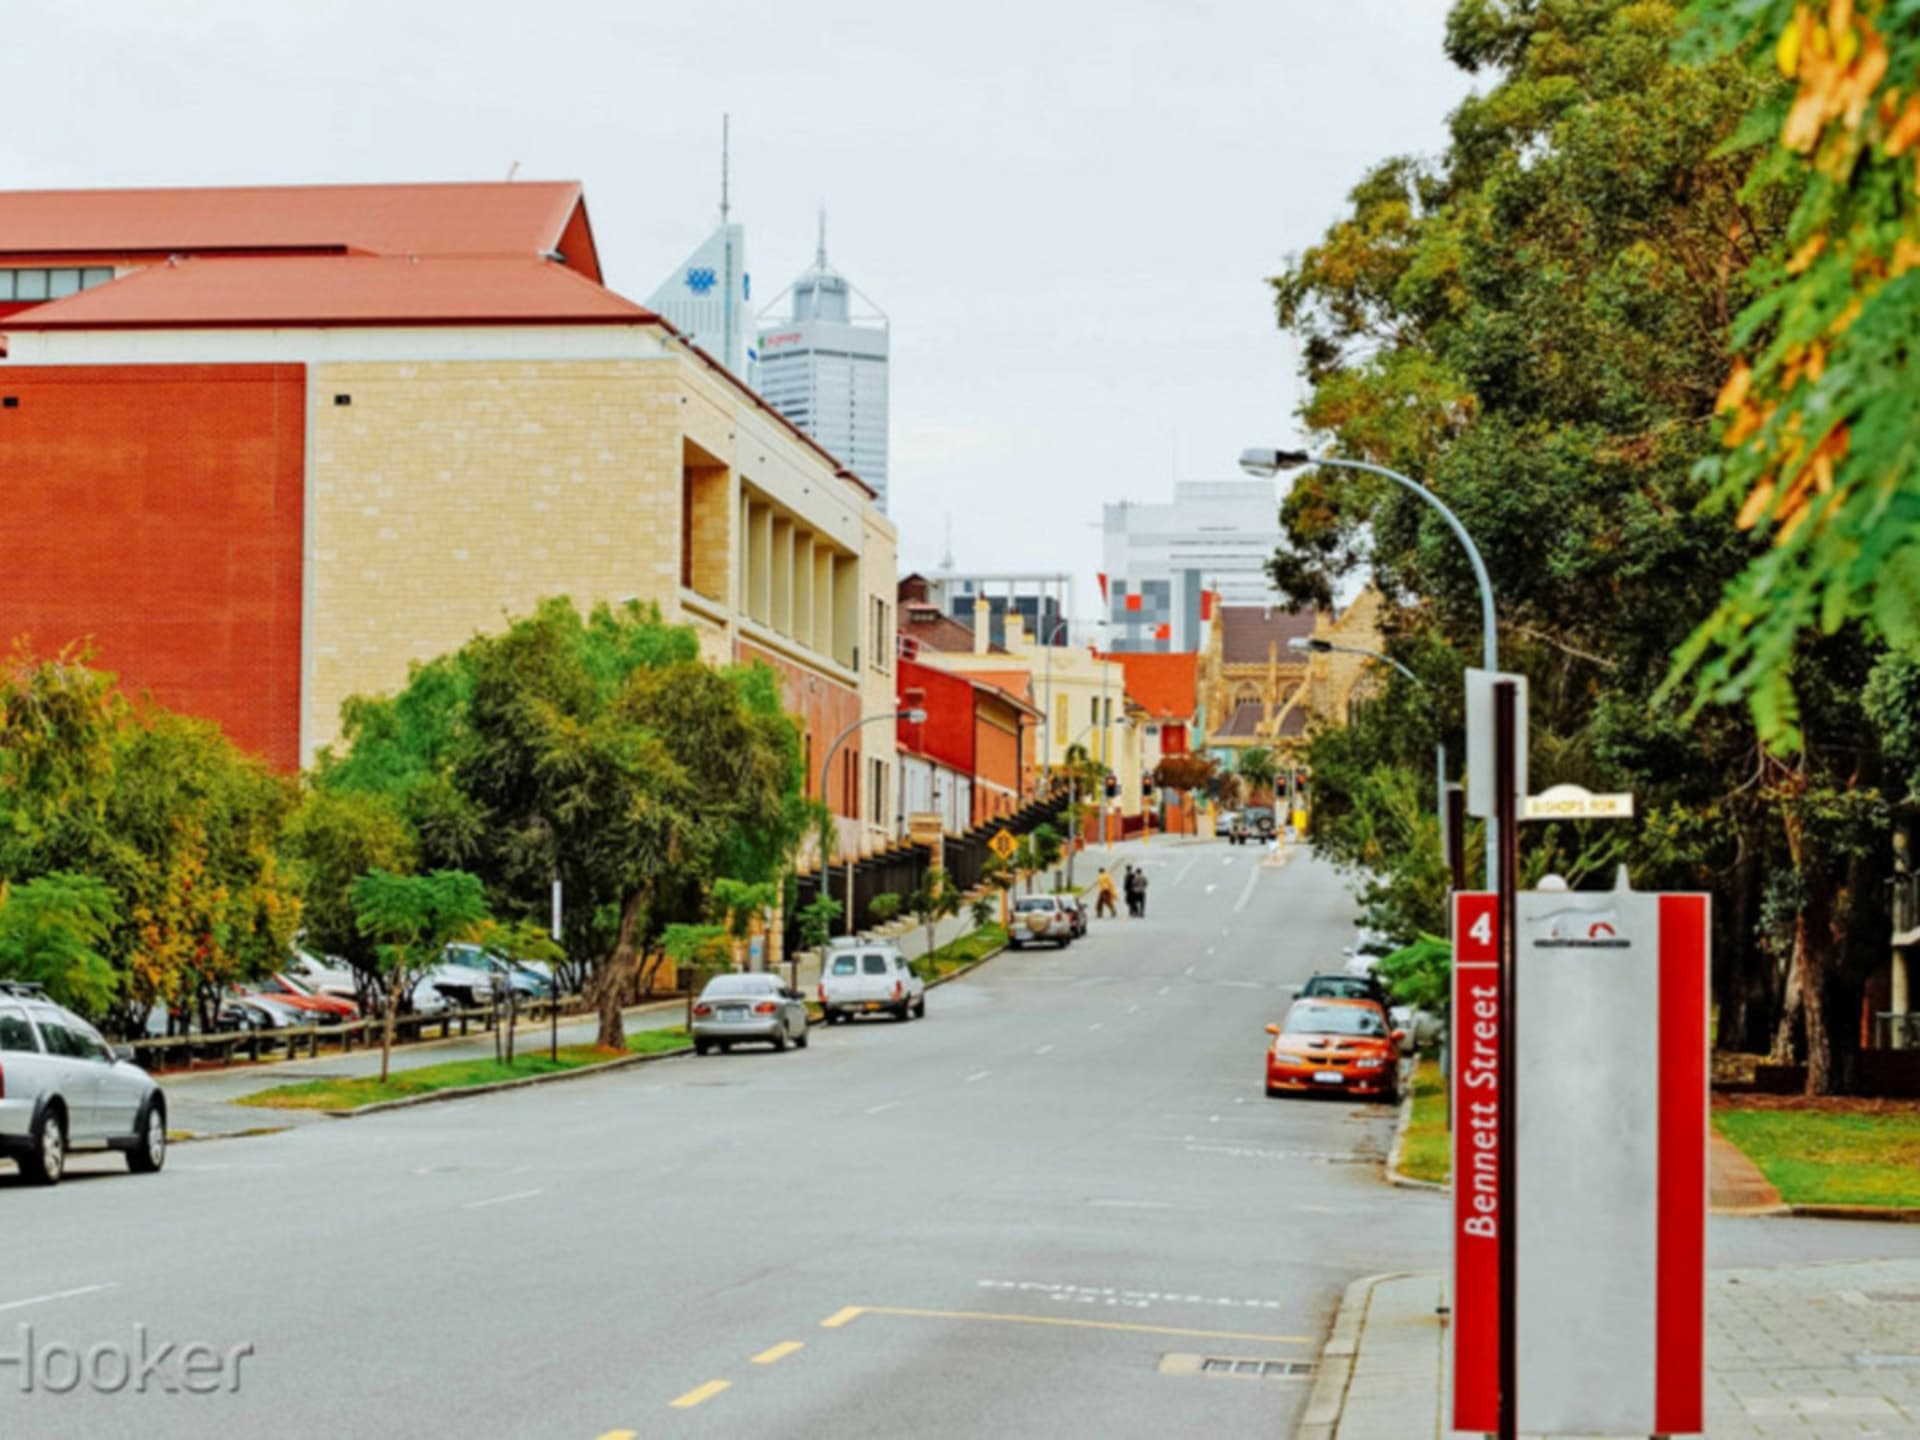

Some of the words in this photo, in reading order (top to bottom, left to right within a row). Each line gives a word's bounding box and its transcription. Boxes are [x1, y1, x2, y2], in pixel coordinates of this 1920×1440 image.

[1468, 912, 1492, 945] 4
[1464, 985, 1497, 1090] Street
[1464, 1102, 1497, 1239] Bennett
